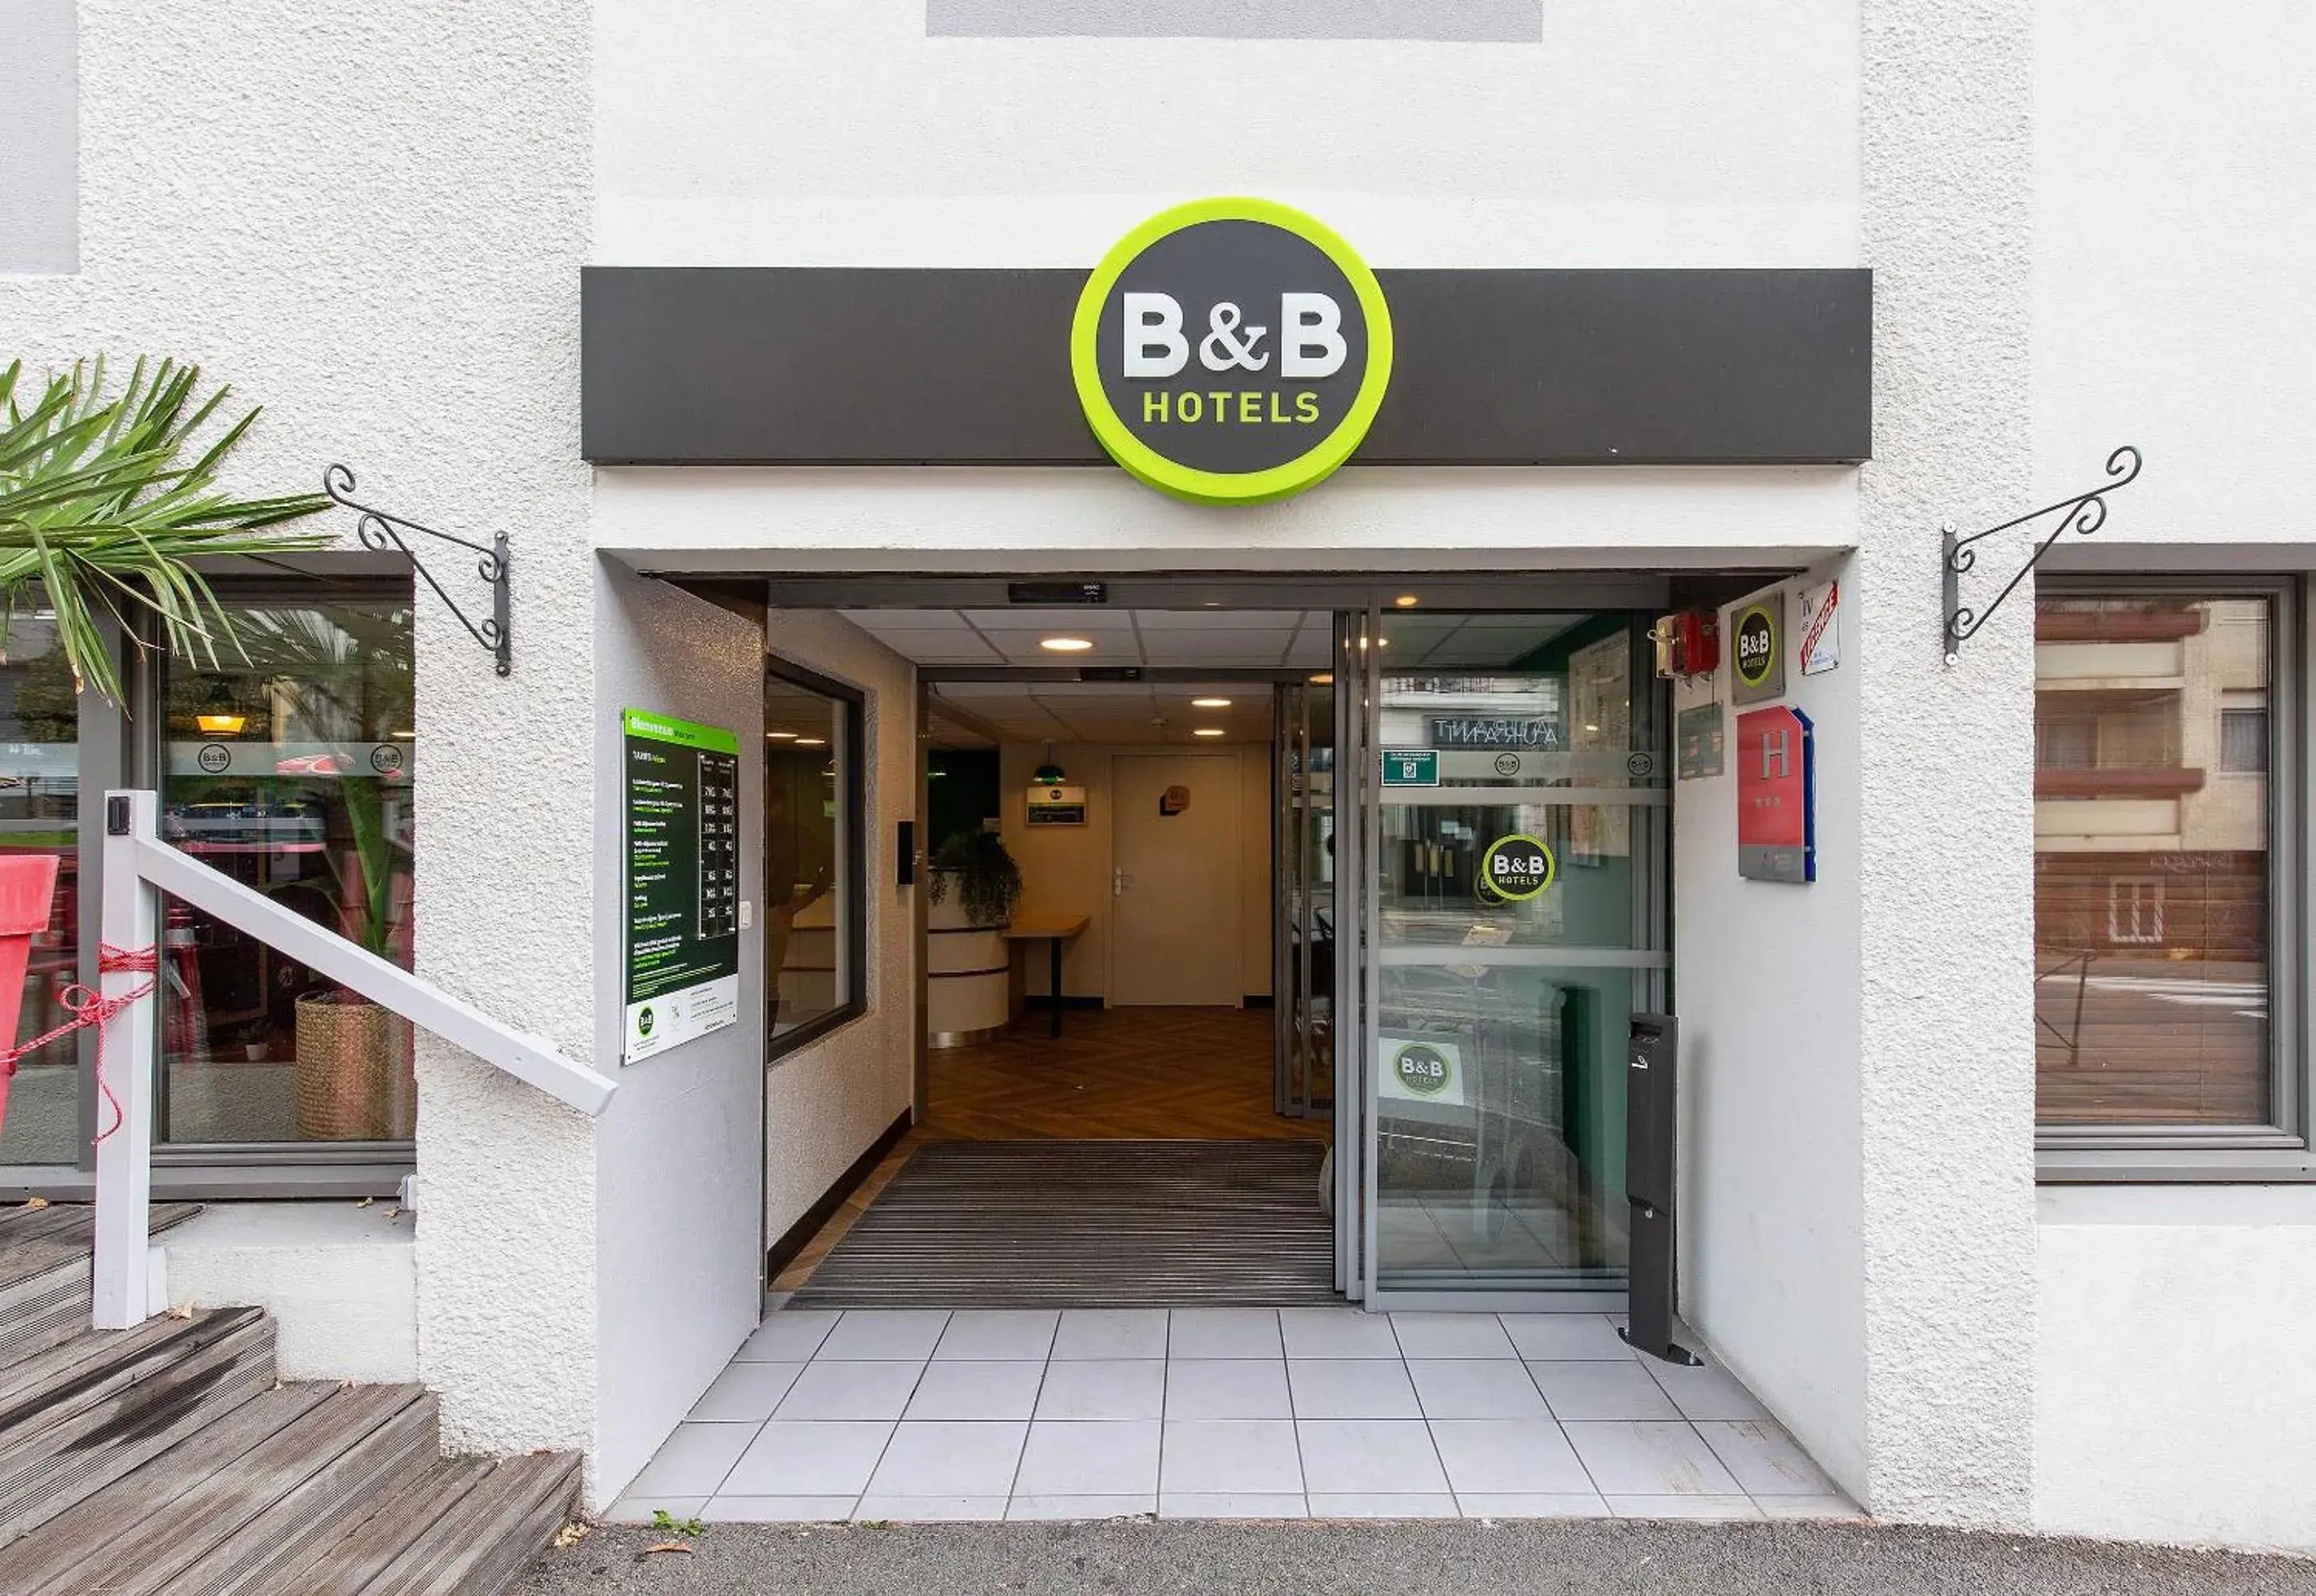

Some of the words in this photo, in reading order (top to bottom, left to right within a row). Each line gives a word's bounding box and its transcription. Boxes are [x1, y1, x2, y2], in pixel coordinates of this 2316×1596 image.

[1124, 291, 1347, 378] B&B
[1143, 391, 1320, 423] HOTELS
[1740, 629, 1769, 657] B&B
[1762, 730, 1790, 779] H
[1494, 855, 1545, 874] B&B
[1402, 1057, 1442, 1076] B&B
